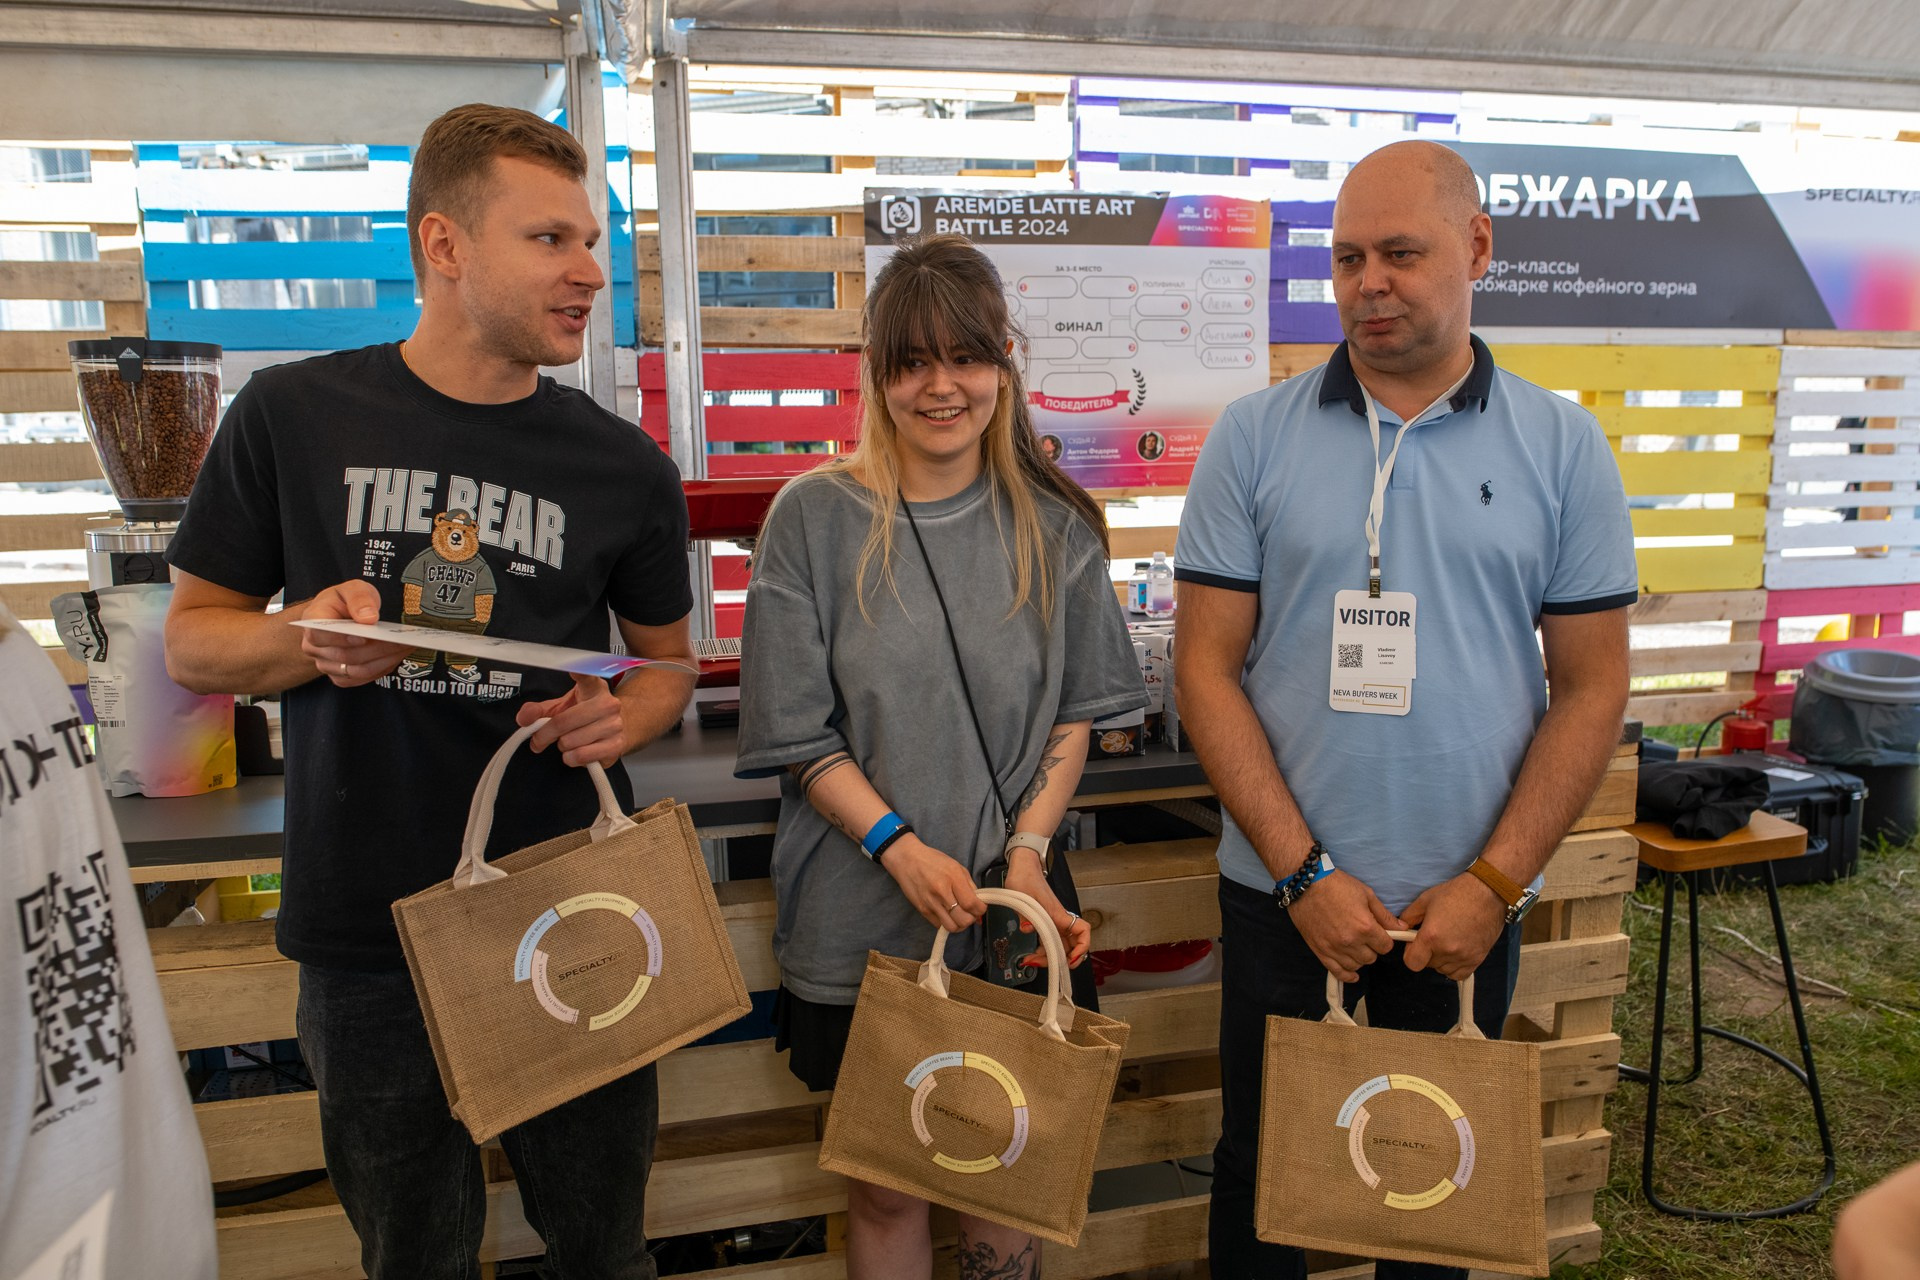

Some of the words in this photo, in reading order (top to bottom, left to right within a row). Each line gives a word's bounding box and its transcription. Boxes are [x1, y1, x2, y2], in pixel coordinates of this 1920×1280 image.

[934, 197, 1024, 215] AREMDE
[1029, 198, 1091, 215] LATTE
[1095, 198, 1136, 216] ART
[936, 218, 1014, 236] BATTLE
[1018, 219, 1070, 236] 2024
[1487, 259, 1580, 277] ер-классы
[1473, 276, 1548, 296] обжарке
[1552, 277, 1645, 298] кофейного
[1649, 280, 1698, 299] зерна
[1054, 322, 1103, 332] ФИНАЛ
[1044, 398, 1114, 411] ПОБЕДИТЕЛЬ
[344, 467, 438, 536] THE
[447, 474, 566, 570] BEAR
[510, 561, 536, 574] PARIS
[435, 583, 462, 604] 47
[1340, 608, 1410, 627] VISITOR
[404, 678, 446, 694] SCOLD
[450, 681, 474, 696] TOO
[478, 684, 514, 699] MUCH
[1333, 688, 1351, 696] NEVA
[1352, 690, 1378, 698] BUYERS
[1379, 692, 1398, 700] WEEK
[575, 897, 601, 906] SPECIALTY
[646, 924, 656, 946] SPECIALTY
[518, 951, 526, 978] SPECIALTY
[524, 932, 536, 950] COFFEE
[534, 918, 548, 932] BEANS
[909, 1066, 924, 1084] SPECIALTY
[925, 1058, 939, 1069] COFFEE
[981, 1060, 1001, 1074] SPECIALTY
[1406, 1080, 1430, 1090] SPECIALTY
[1340, 1102, 1353, 1124] SPECIALTY
[1352, 1089, 1366, 1103] COFFEE
[1366, 1082, 1380, 1091] BEANS
